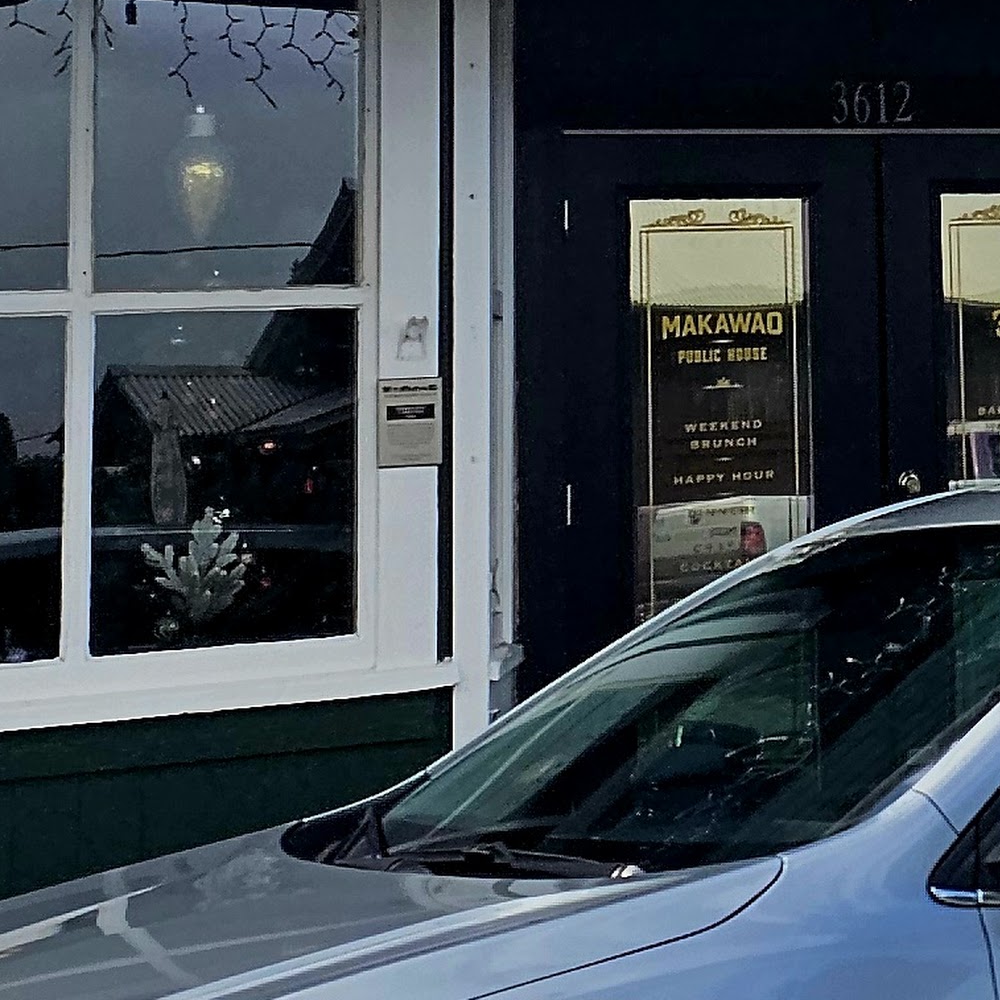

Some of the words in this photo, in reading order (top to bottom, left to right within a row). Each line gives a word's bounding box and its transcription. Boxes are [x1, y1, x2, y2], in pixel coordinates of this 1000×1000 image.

[830, 80, 915, 123] 3612
[661, 311, 784, 340] MAKAWAO
[677, 348, 721, 364] PUBLIC
[727, 346, 768, 362] HOUSE
[684, 419, 763, 433] WEEKEND
[690, 437, 758, 450] BRUNCH
[673, 473, 725, 485] HAPPY
[732, 469, 775, 481] HOUR
